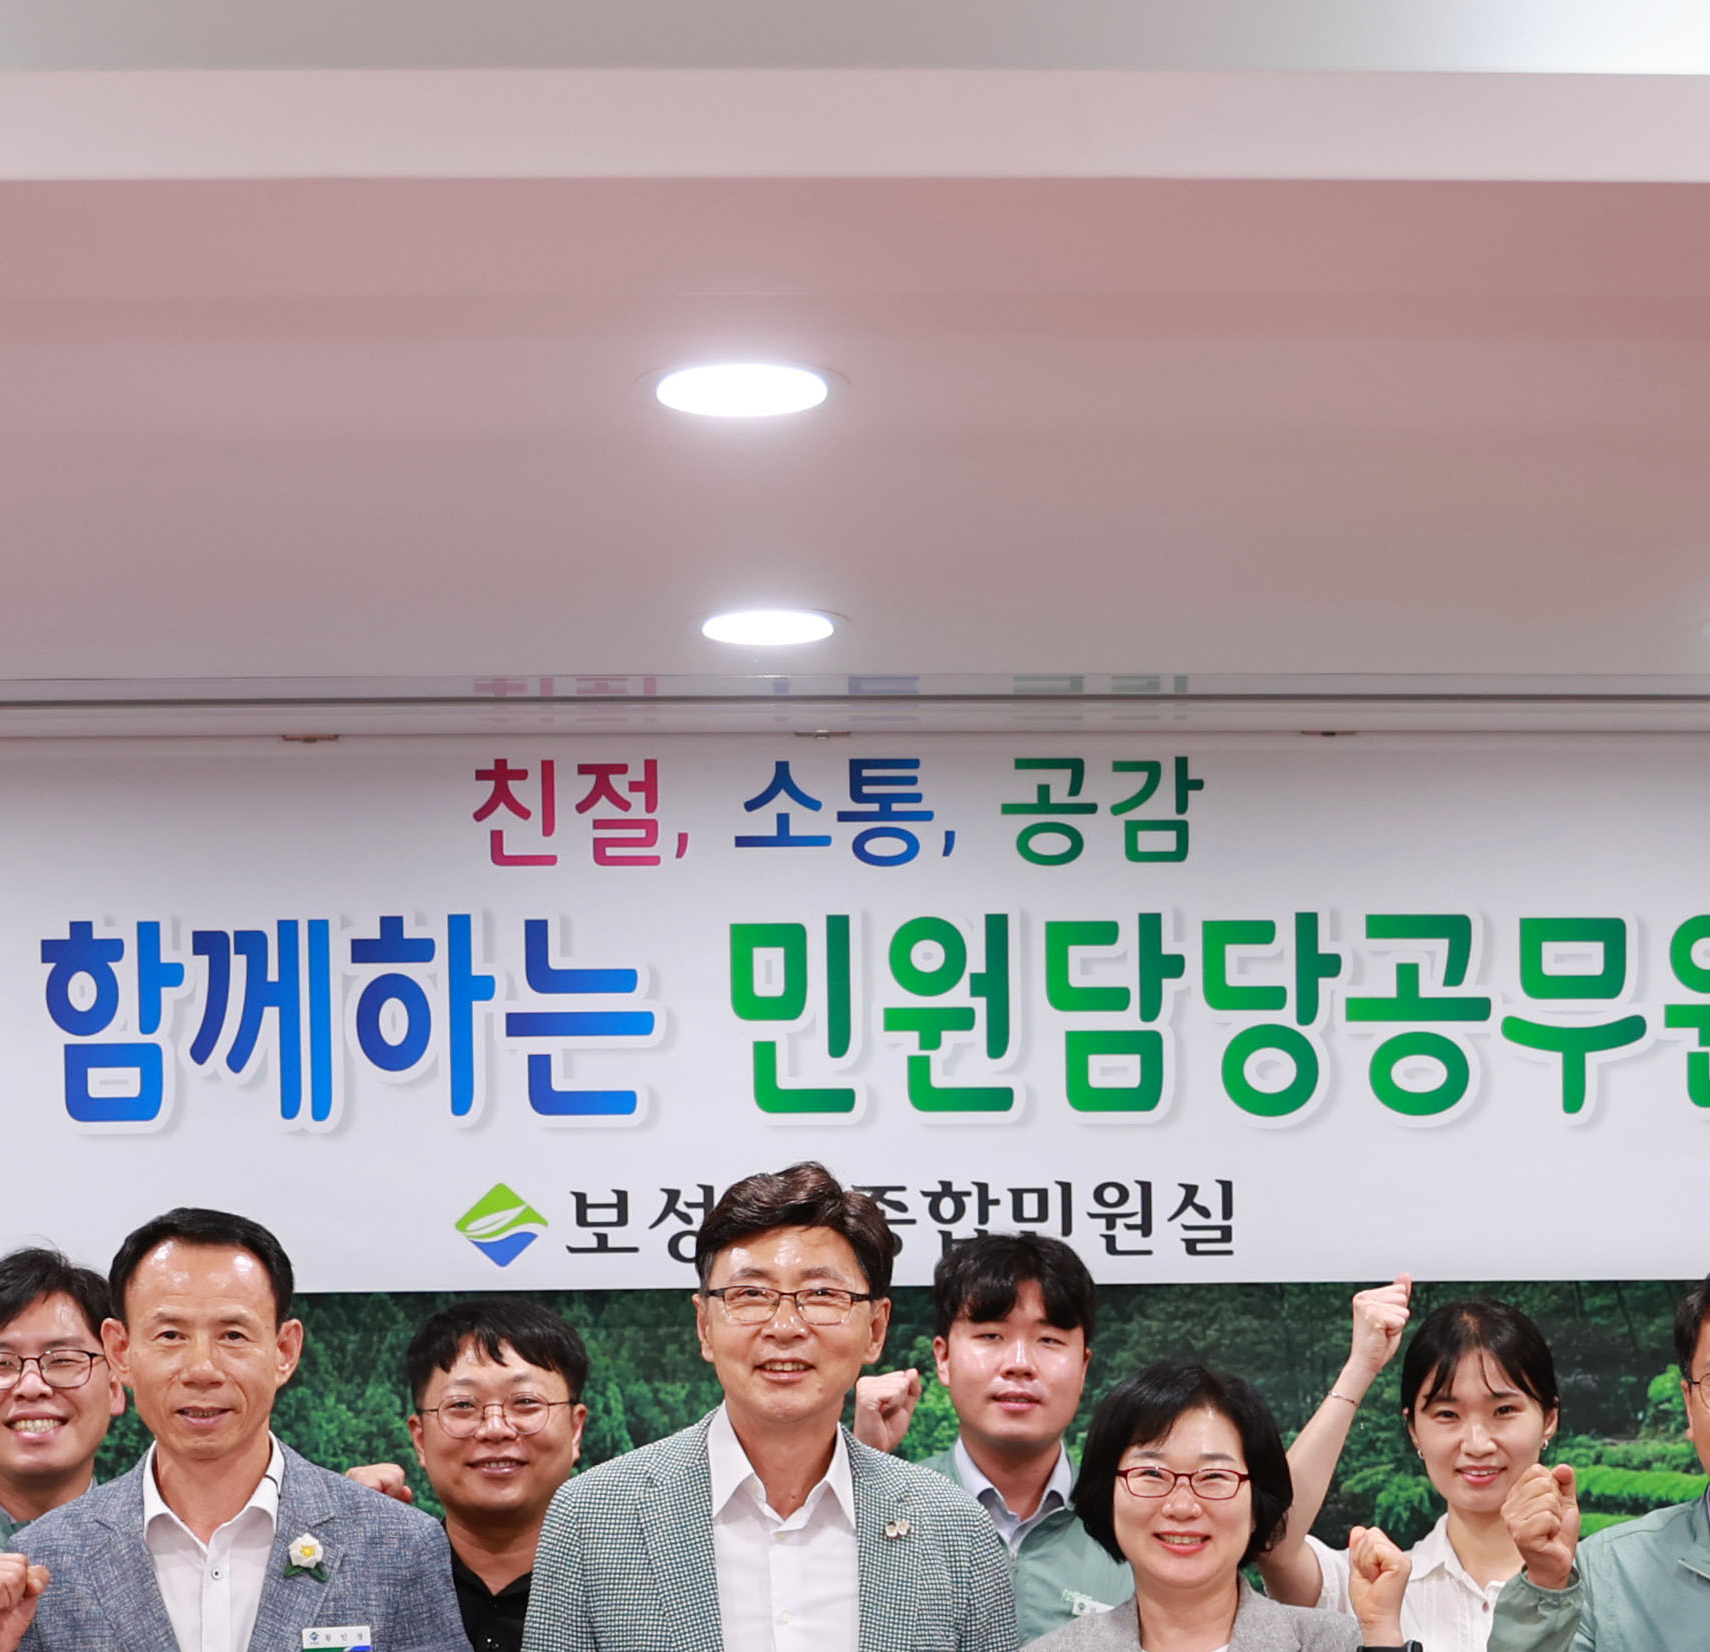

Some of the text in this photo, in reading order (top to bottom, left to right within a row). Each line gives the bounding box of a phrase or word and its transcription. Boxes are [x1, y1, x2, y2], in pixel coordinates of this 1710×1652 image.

[473, 757, 1205, 867] 친절, 소통, 공감
[41, 913, 656, 1124] 함께하는
